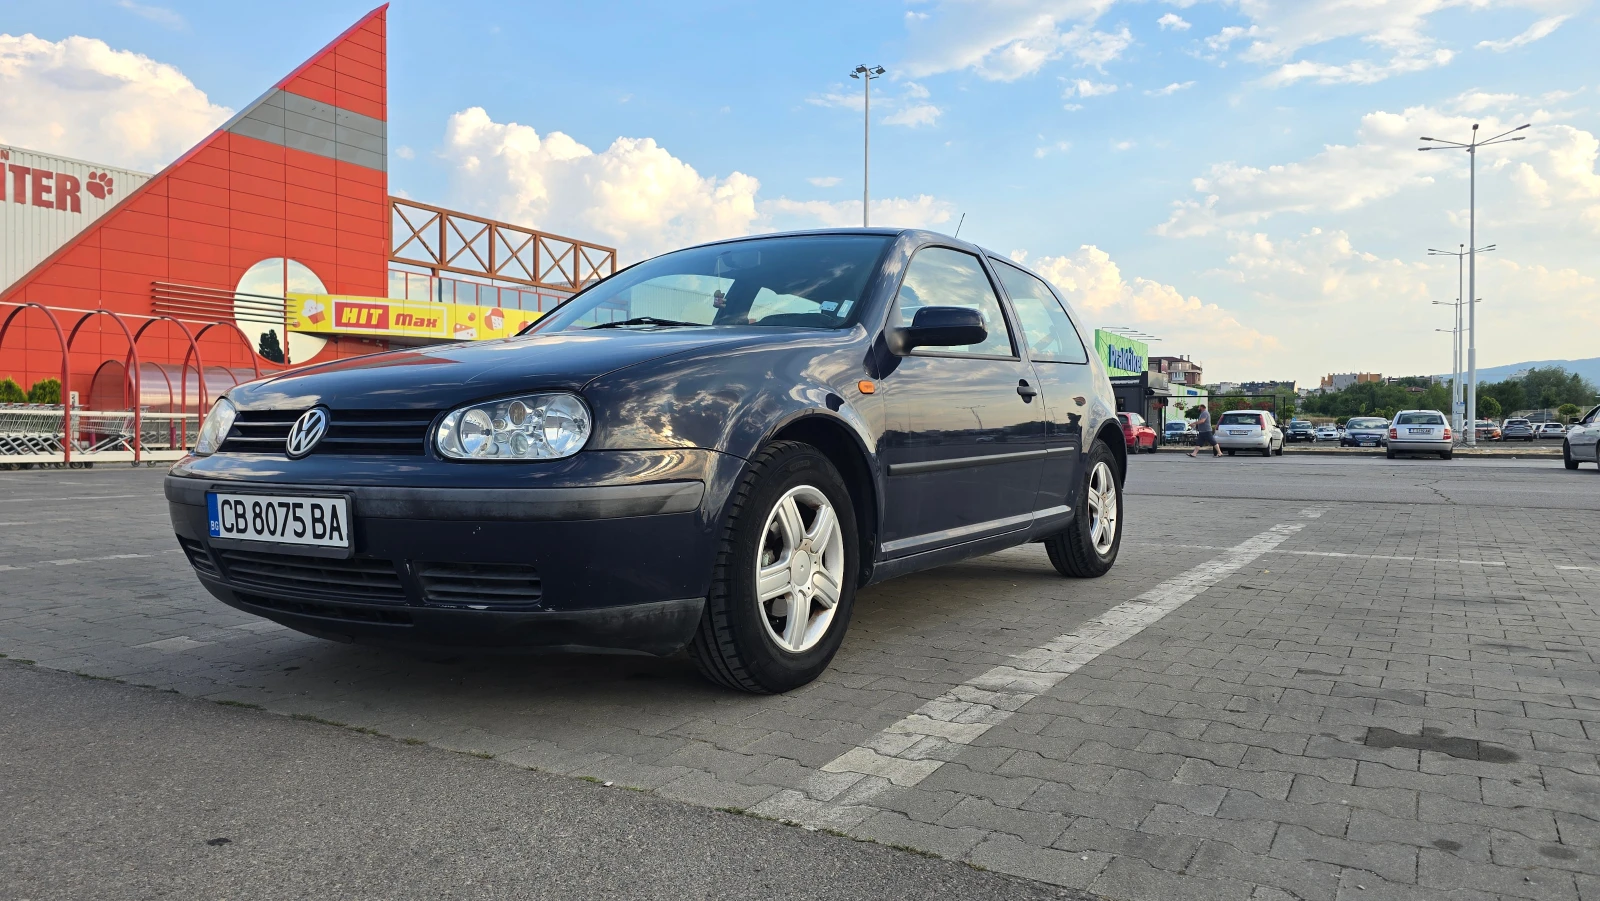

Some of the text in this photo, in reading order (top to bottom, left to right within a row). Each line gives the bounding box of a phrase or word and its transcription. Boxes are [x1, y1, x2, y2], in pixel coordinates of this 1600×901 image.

[0, 162, 81, 214] TER
[341, 307, 437, 328] HIT Max
[211, 520, 219, 531] BG
[221, 499, 343, 541] CB 8075 BA
